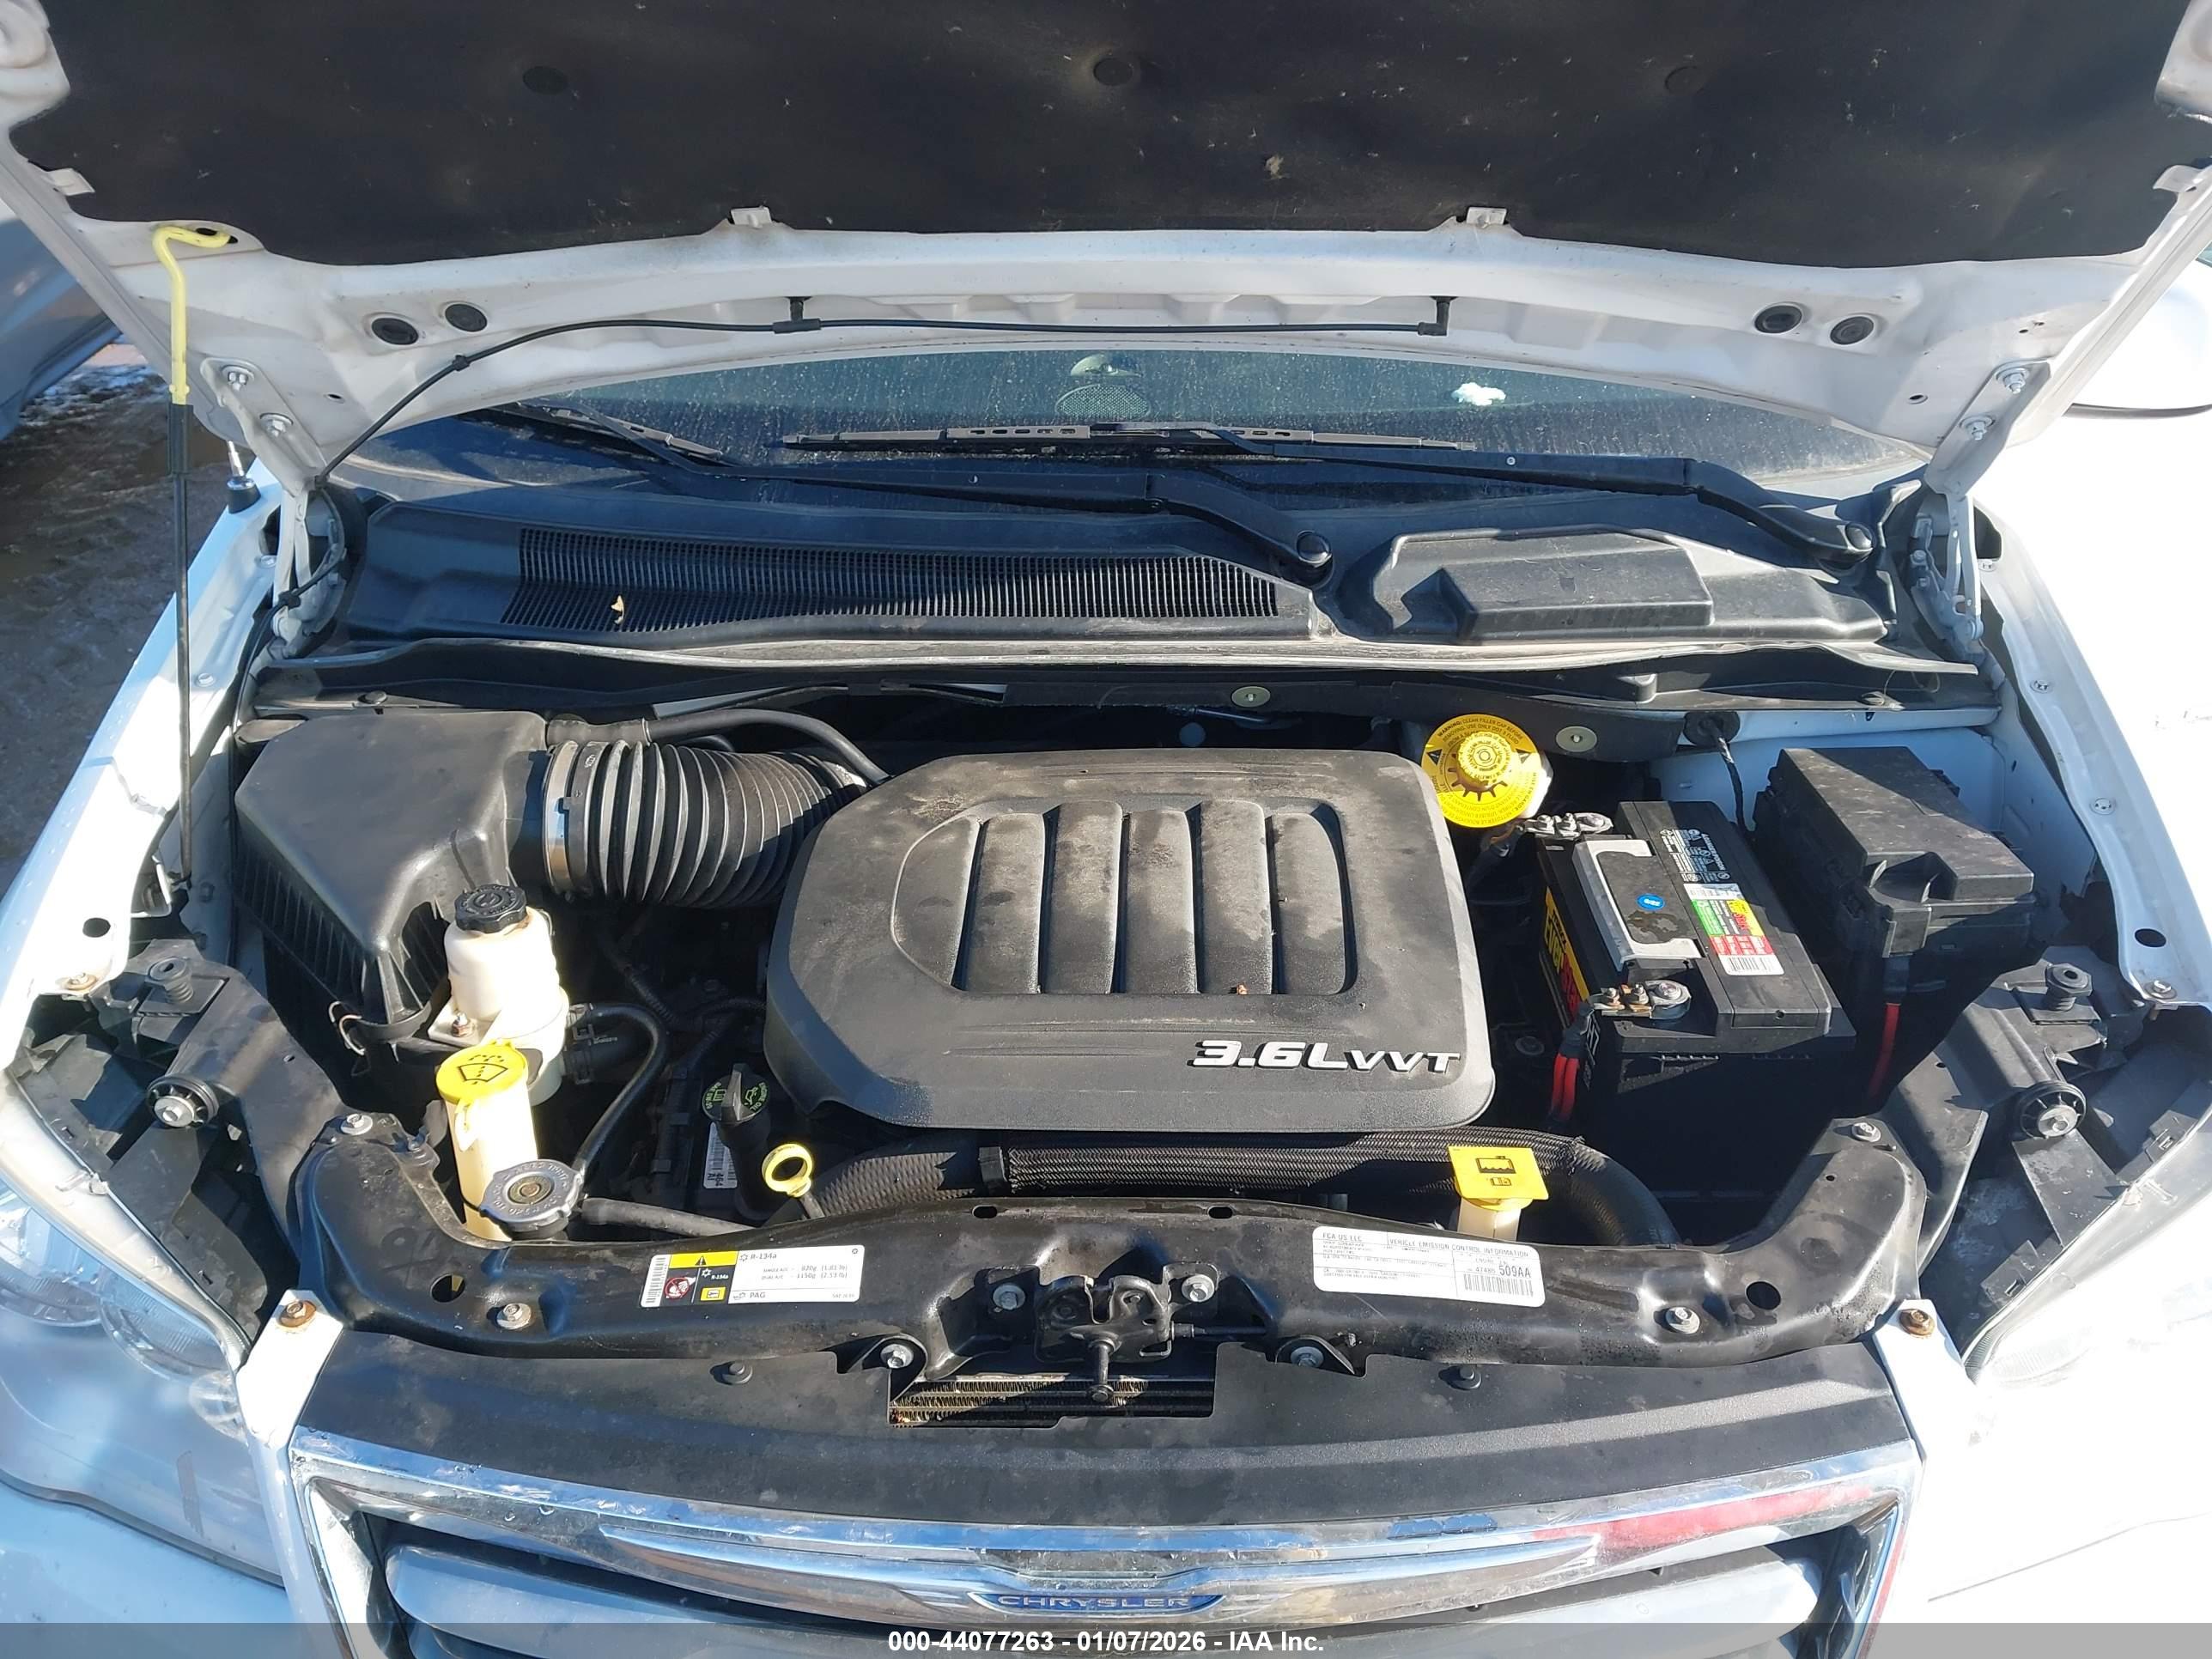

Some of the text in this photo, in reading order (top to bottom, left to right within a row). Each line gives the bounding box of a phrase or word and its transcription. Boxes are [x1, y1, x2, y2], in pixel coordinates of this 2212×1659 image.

[1389, 1238, 1416, 1247] VEHICLE
[1419, 1241, 1449, 1250] EMISSION
[1451, 1243, 1480, 1253] CONTROL
[1483, 1247, 1528, 1257] INFORMATION
[1498, 1265, 1531, 1278] 509AA
[997, 1595, 1192, 1608] CHRYSLER
